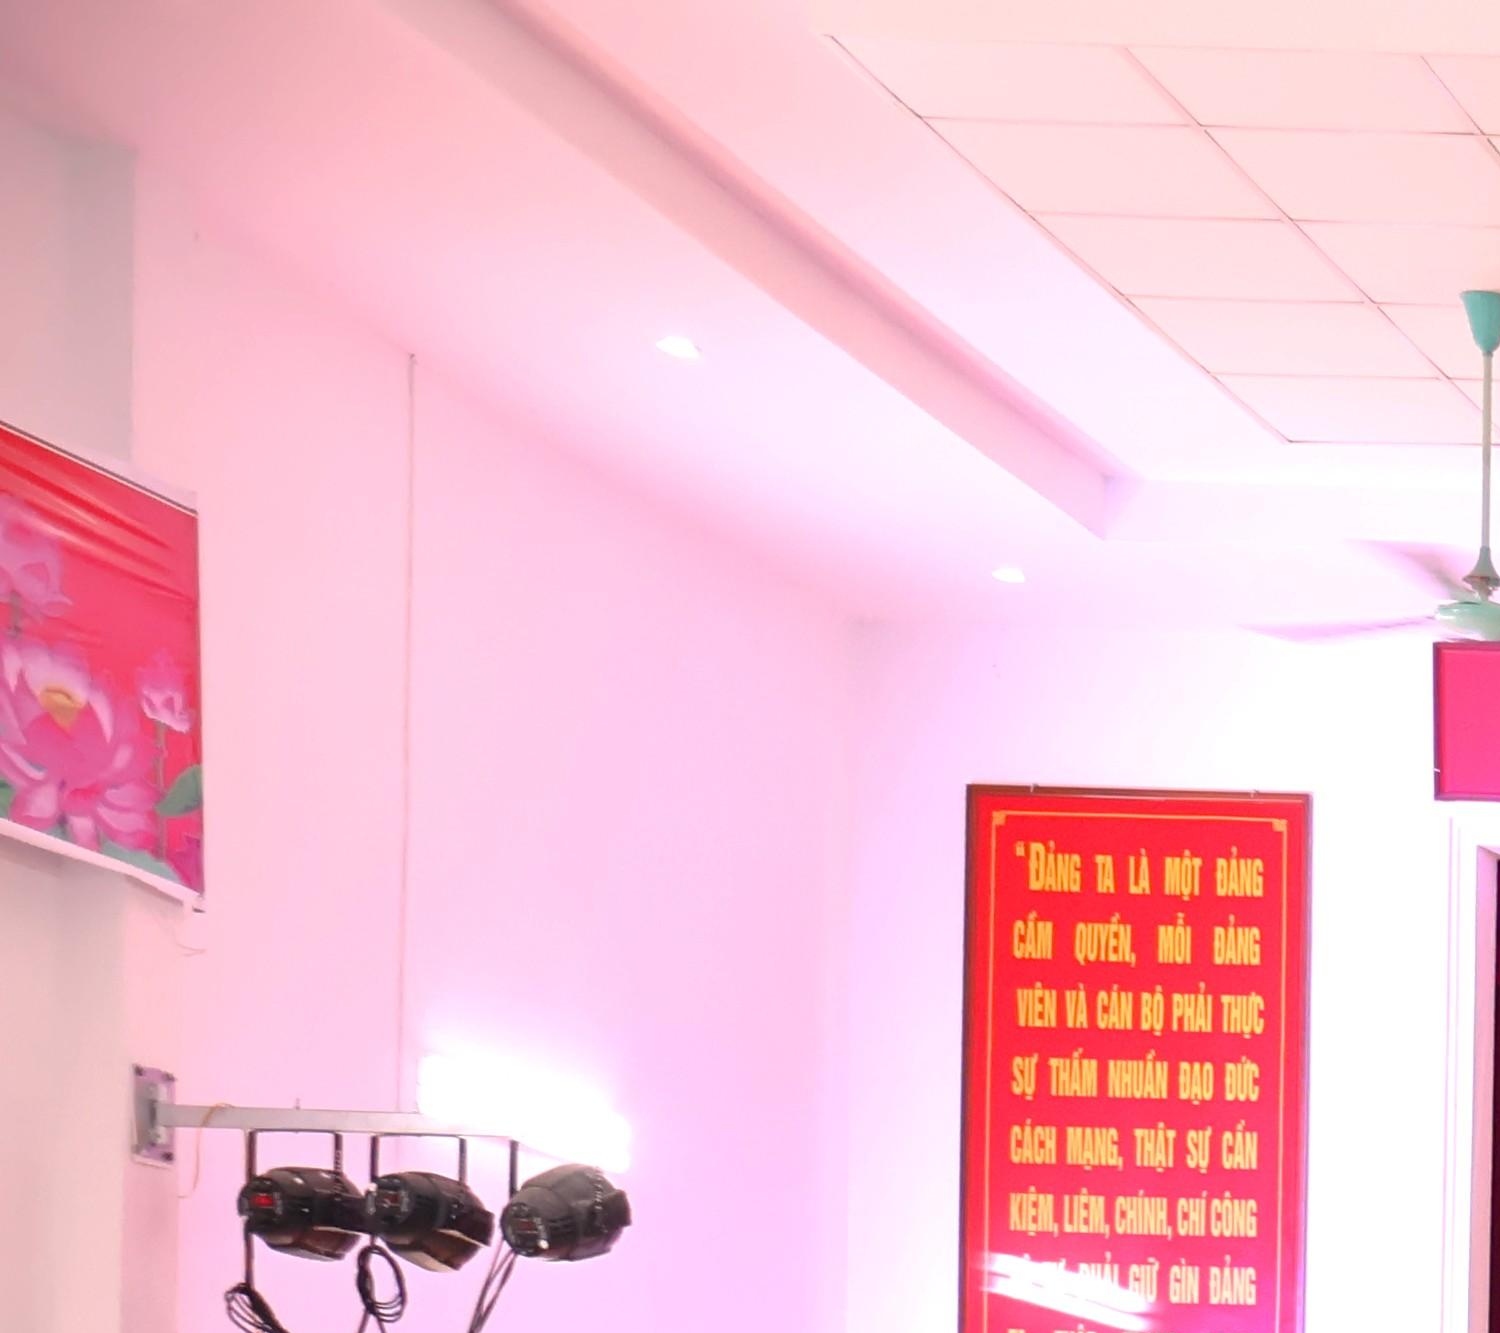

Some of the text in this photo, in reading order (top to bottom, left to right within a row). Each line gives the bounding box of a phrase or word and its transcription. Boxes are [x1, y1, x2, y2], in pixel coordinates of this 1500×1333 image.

[1095, 855, 1114, 893] TA
[1129, 849, 1150, 894] LÀ
[1165, 850, 1202, 900] MỘT
[1216, 847, 1263, 896] ĐẢNG
[1214, 915, 1260, 965] ĐẢNG
[1017, 982, 1264, 1038] VIÊN VÀ CÁN BỘ PHẢI THỰC
